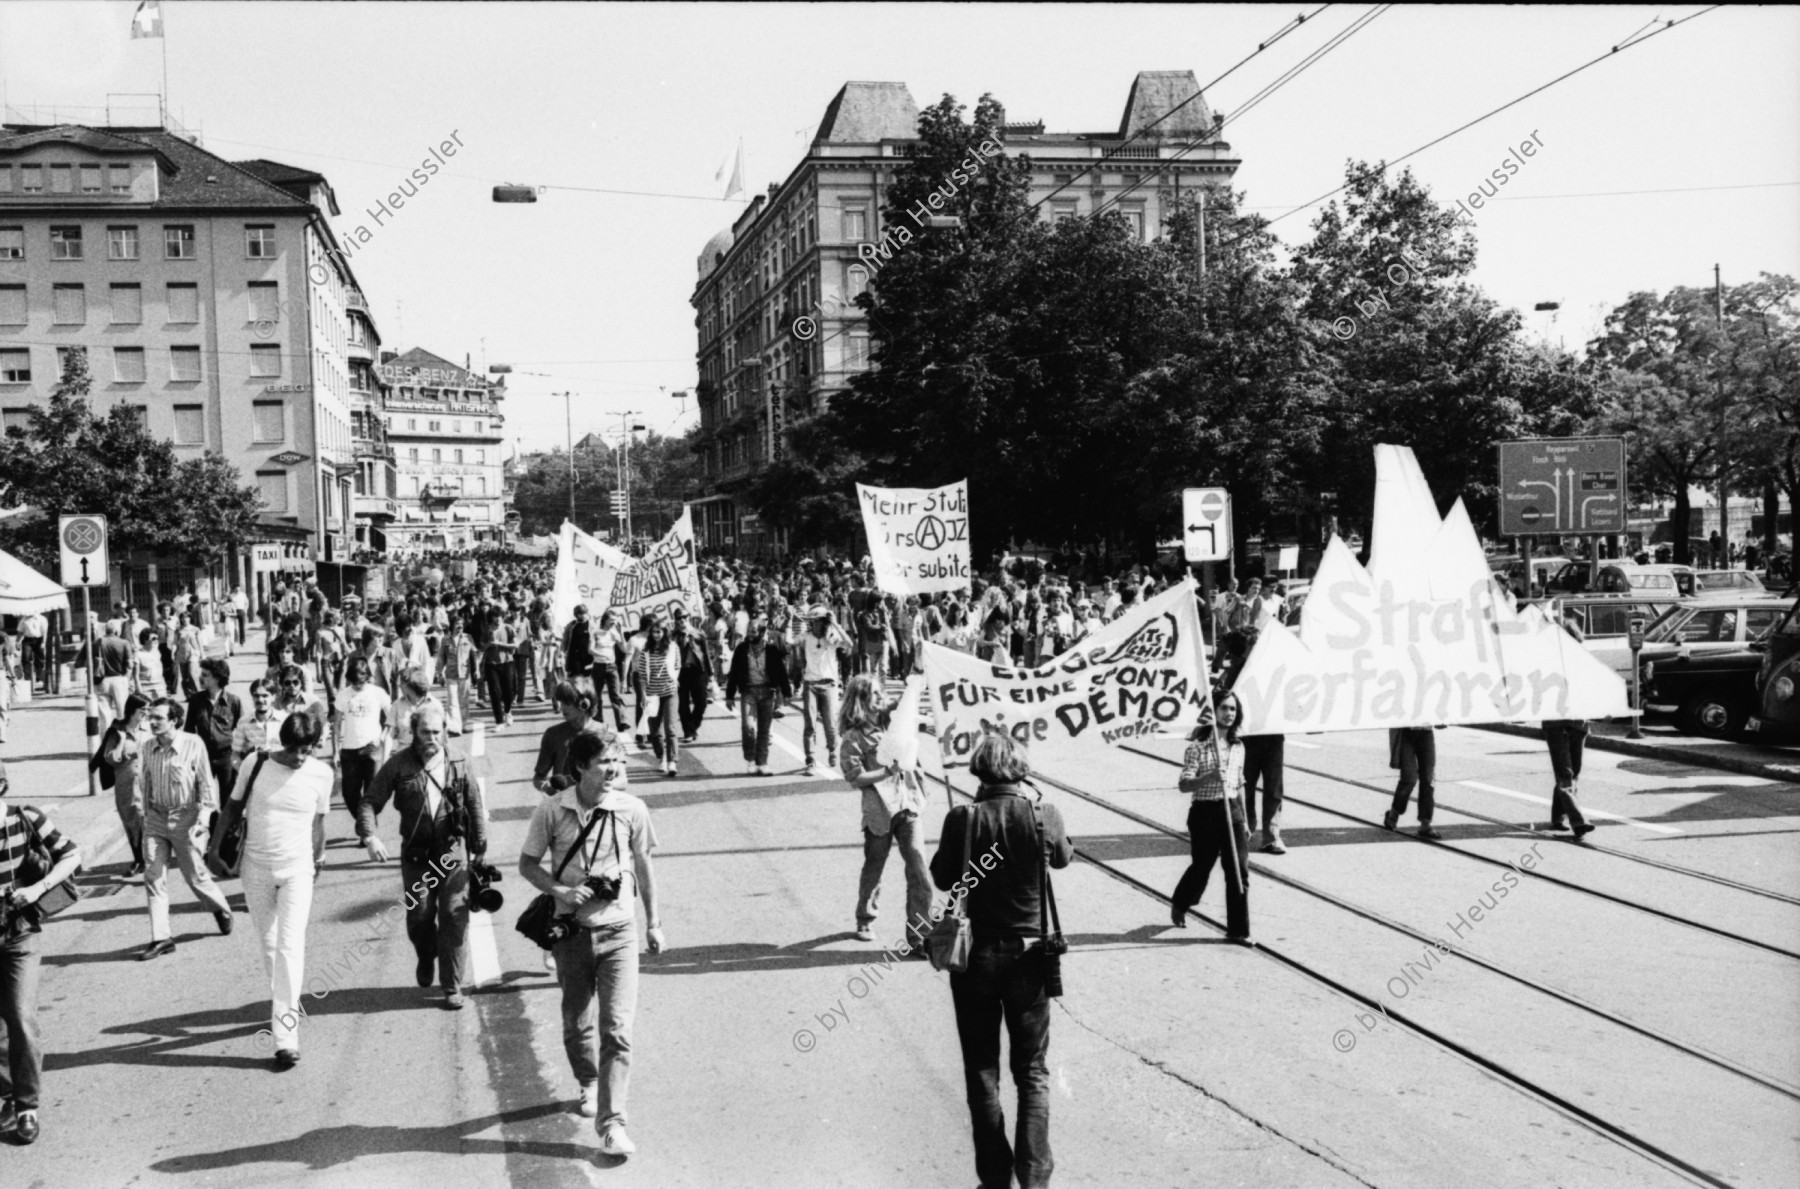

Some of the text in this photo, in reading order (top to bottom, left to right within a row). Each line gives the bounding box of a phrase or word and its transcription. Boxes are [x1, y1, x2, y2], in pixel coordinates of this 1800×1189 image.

[257, 550, 277, 560] TAXI
[335, 538, 345, 550] P
[939, 677, 1002, 712] FÜR
[1010, 679, 1077, 705] EINE
[1055, 687, 1182, 738] DEMO
